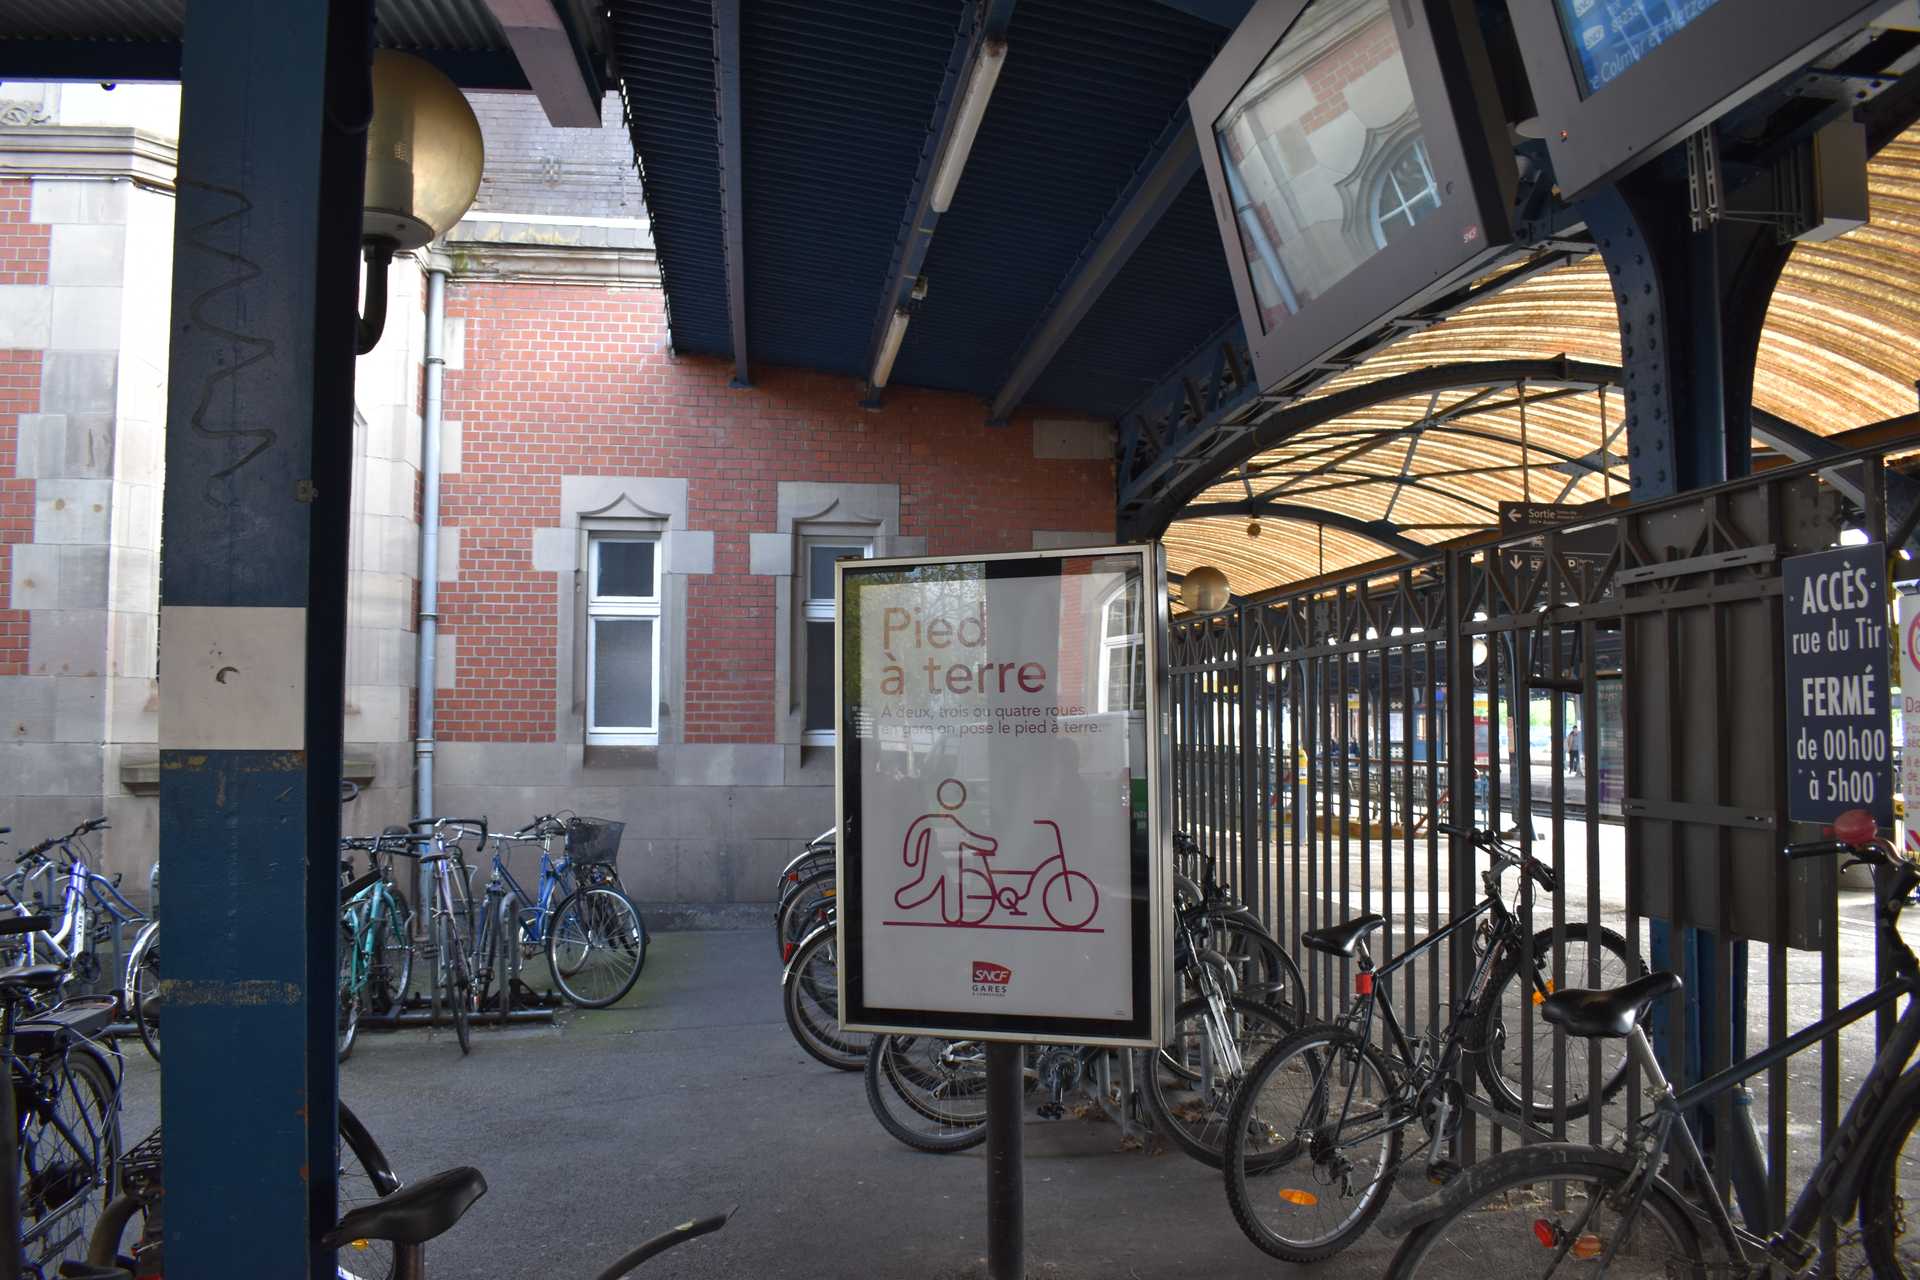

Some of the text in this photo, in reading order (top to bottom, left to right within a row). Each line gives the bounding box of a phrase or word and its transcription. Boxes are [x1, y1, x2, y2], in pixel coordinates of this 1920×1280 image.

[1528, 508, 1556, 520] Sortie
[1802, 560, 1869, 615] ACCÈS
[883, 601, 986, 650] Pied
[1793, 617, 1882, 655] rue du Tir
[880, 652, 1047, 695] à terre
[1802, 664, 1876, 716] FERMÉ
[896, 703, 935, 720] deux,
[939, 705, 969, 719] trois
[973, 706, 991, 718] ou
[995, 705, 1041, 720] quatre
[1046, 704, 1089, 717] roues,
[903, 724, 933, 739] gare
[937, 724, 955, 736] on
[960, 723, 994, 738] pose
[998, 720, 1011, 734] le
[1015, 719, 1048, 737] pied
[1050, 719, 1060, 734] à
[1063, 720, 1104, 734] terre.
[1797, 727, 1818, 760] de
[1823, 725, 1886, 761] 00h00
[1809, 767, 1875, 803] à 5h00
[972, 984, 1008, 993] GARES
[974, 968, 1009, 982] SNCF
